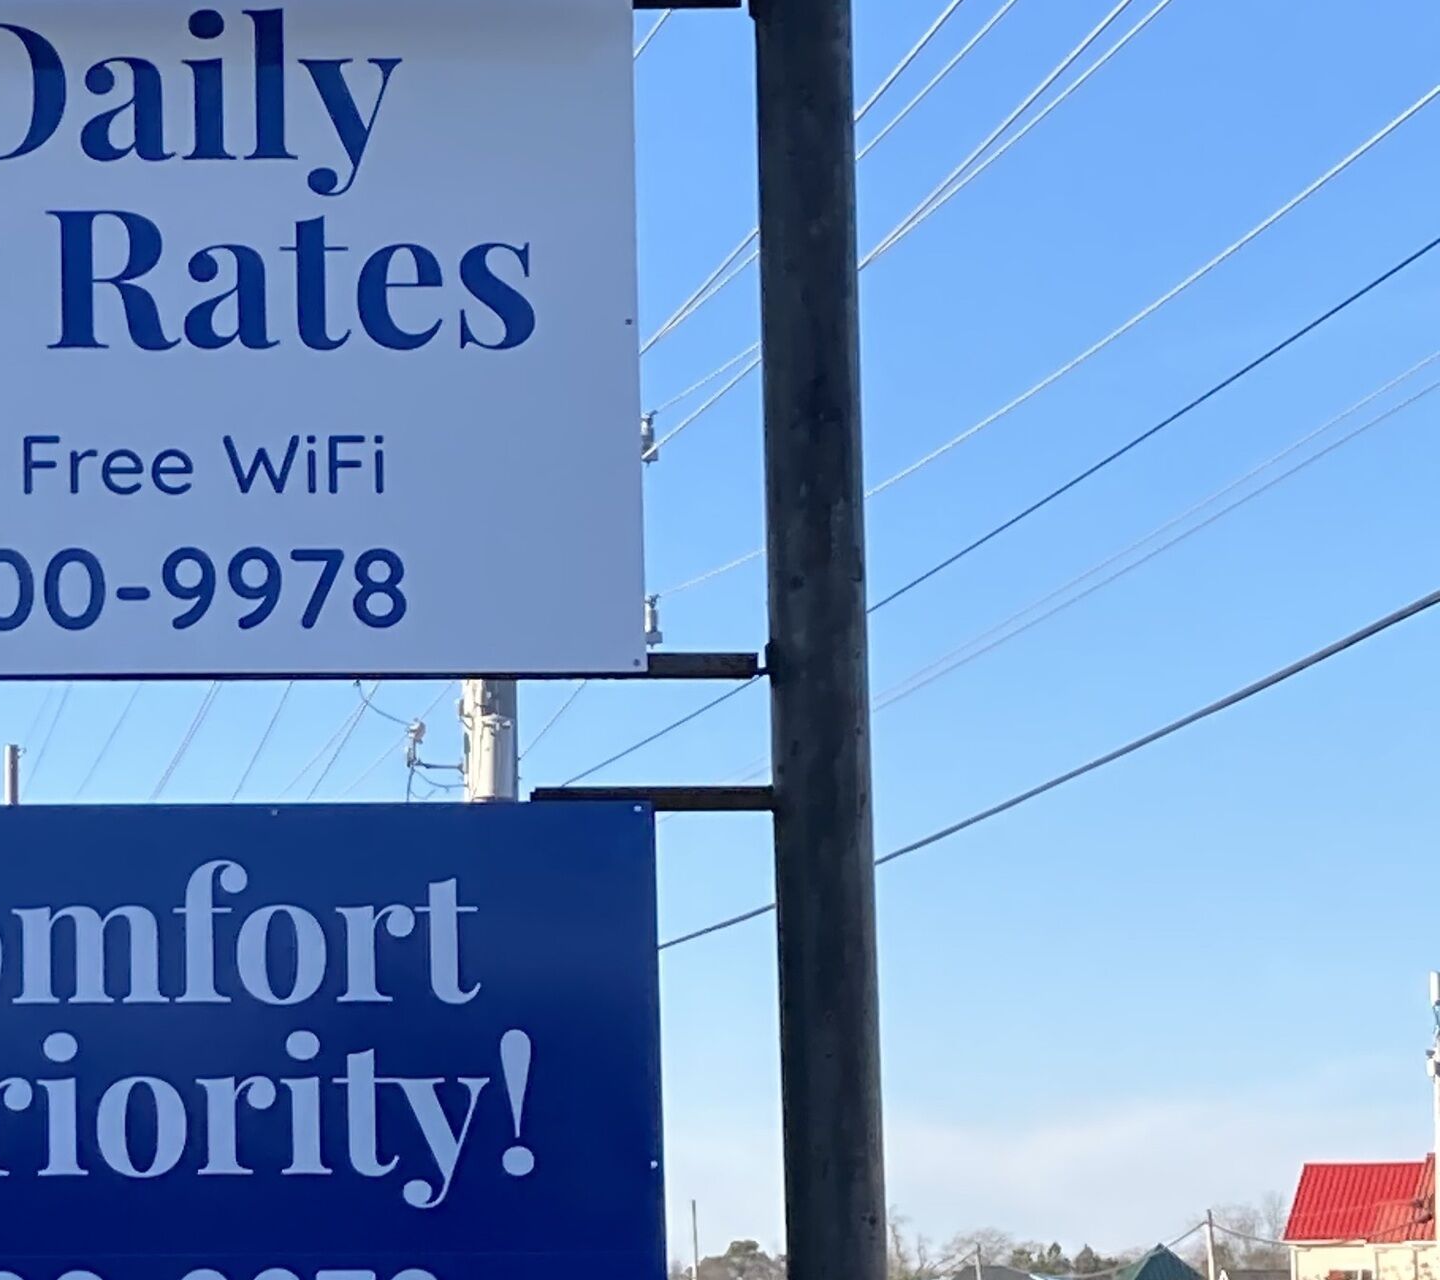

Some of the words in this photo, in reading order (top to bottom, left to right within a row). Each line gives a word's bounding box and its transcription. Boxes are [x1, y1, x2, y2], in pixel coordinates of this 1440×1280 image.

[46, 211, 535, 351] Rates
[23, 435, 194, 496] Free
[222, 434, 384, 495] WiFi
